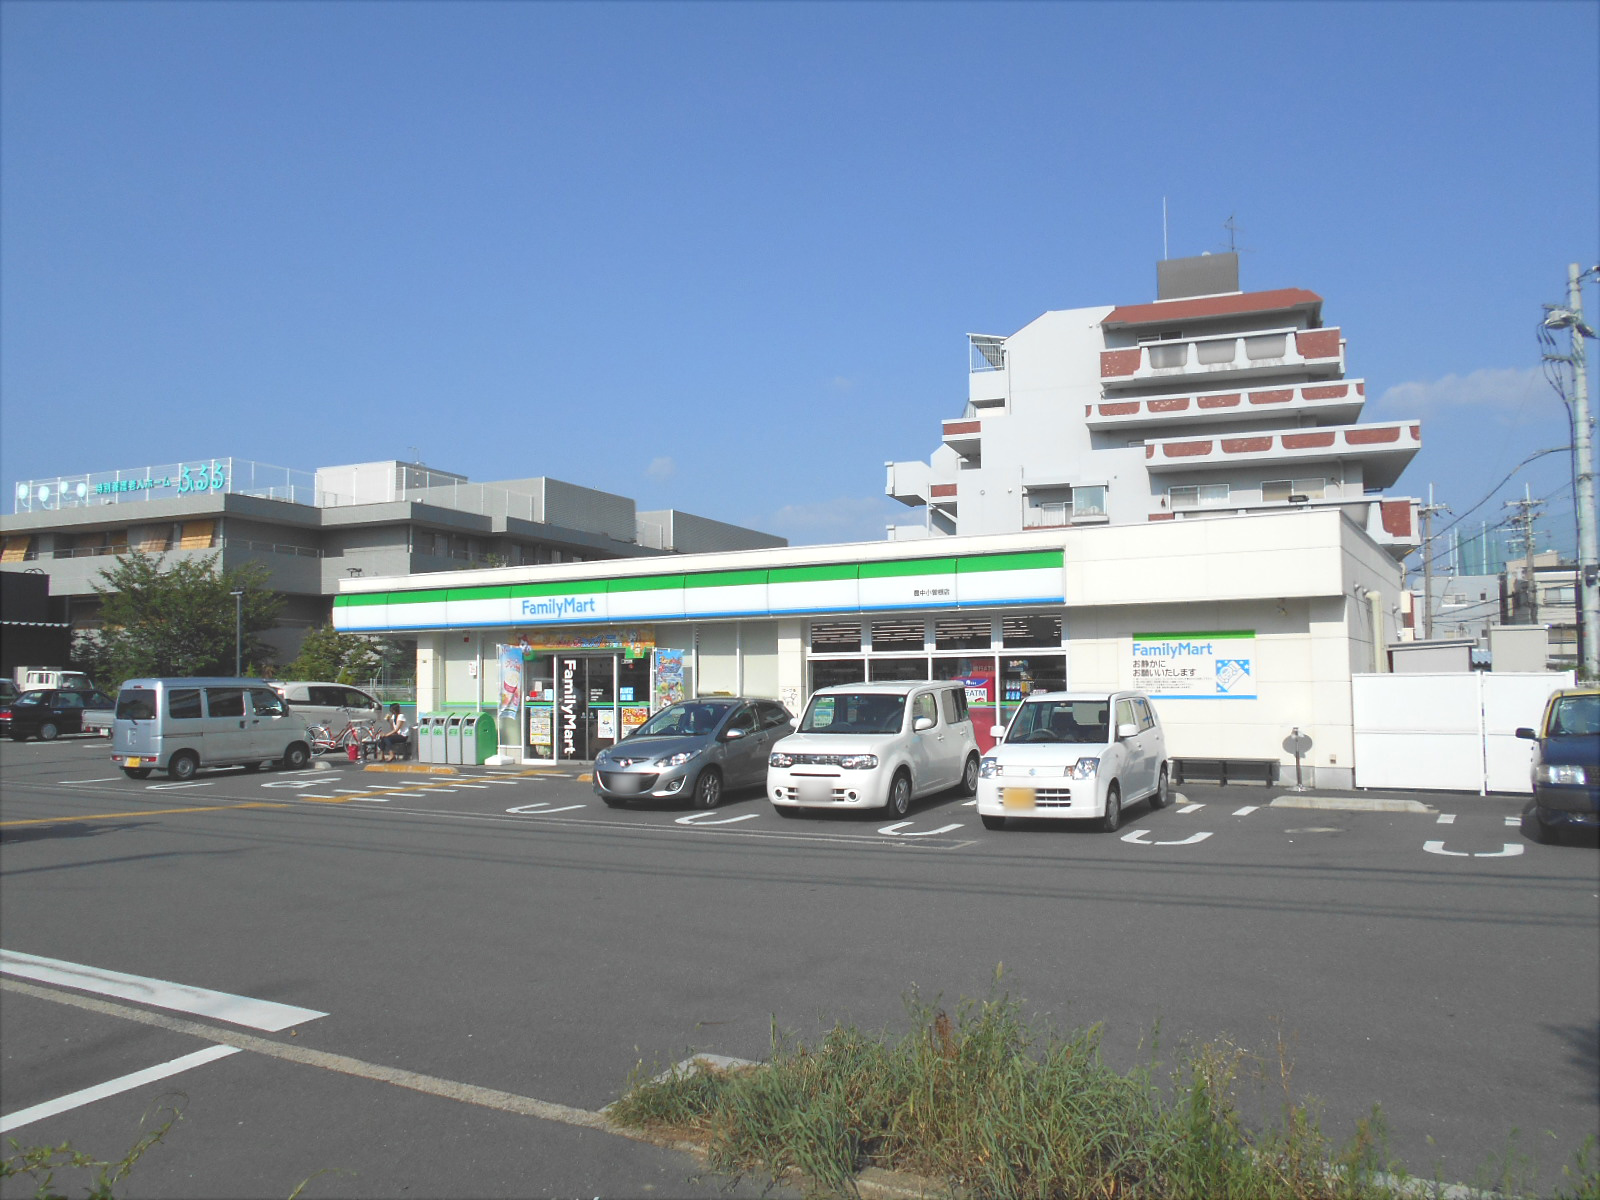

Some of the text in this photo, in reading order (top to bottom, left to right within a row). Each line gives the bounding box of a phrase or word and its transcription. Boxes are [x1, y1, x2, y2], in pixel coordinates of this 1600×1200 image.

[96, 476, 171, 494] 特別養護老人ホーム
[522, 597, 595, 618] FamilyMart
[1132, 642, 1213, 659] FamilyMart
[1132, 660, 1166, 668] お静かに
[1132, 668, 1197, 677] お願いいたします
[561, 659, 577, 755] FamilyMart
